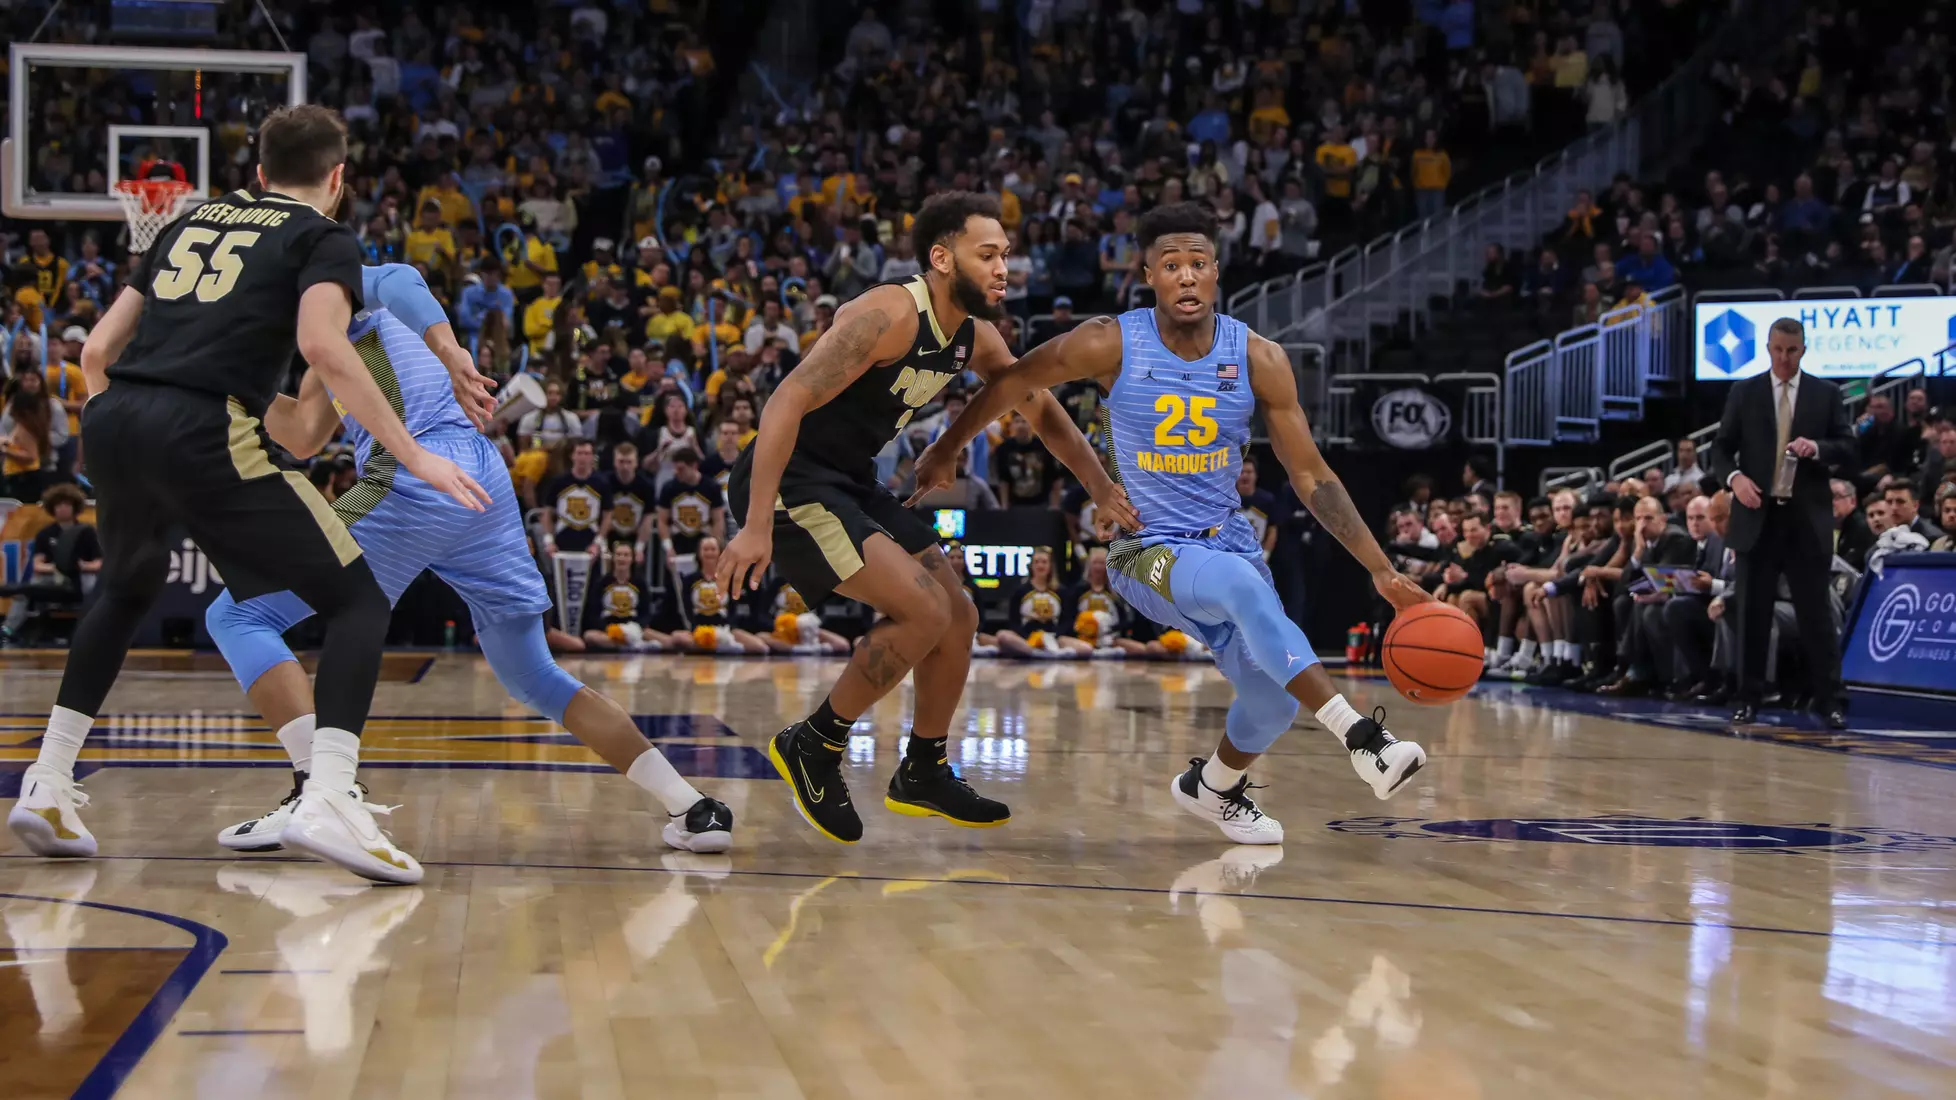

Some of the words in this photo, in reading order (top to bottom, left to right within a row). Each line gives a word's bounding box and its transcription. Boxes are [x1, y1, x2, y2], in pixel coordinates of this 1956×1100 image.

[189, 203, 291, 227] STEFANOVIC
[152, 227, 262, 302] 55
[1800, 305, 1902, 329] HYATT
[1181, 373, 1192, 381] AL
[1154, 394, 1219, 447] 25
[1388, 401, 1433, 437] FOX
[1137, 447, 1230, 475] MARQUETTE
[943, 545, 1034, 576] ETTE
[1924, 592, 1956, 613] GO
